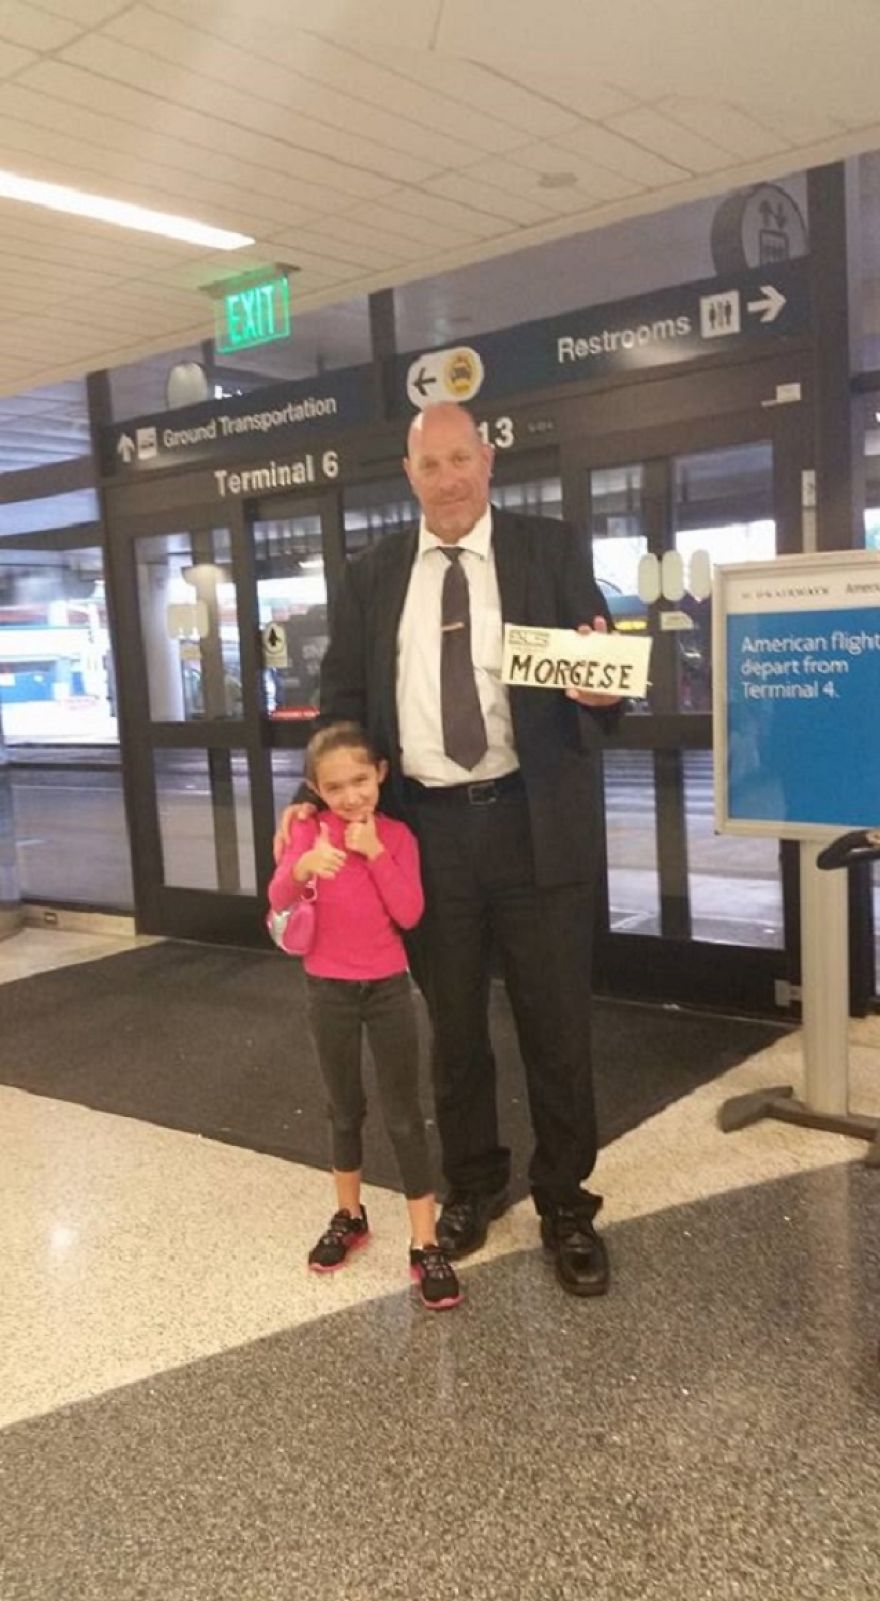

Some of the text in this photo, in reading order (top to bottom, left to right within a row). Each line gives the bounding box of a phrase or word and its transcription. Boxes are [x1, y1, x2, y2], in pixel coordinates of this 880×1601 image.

[226, 285, 275, 346] EXIT
[557, 315, 692, 363] Restrooms
[163, 396, 338, 448] Ground Transportation
[214, 450, 340, 497] Terminal 6
[741, 636, 828, 653] American
[509, 654, 633, 690] MORGESE
[741, 655, 849, 680] depart from
[742, 680, 840, 699] Terminal 4.
